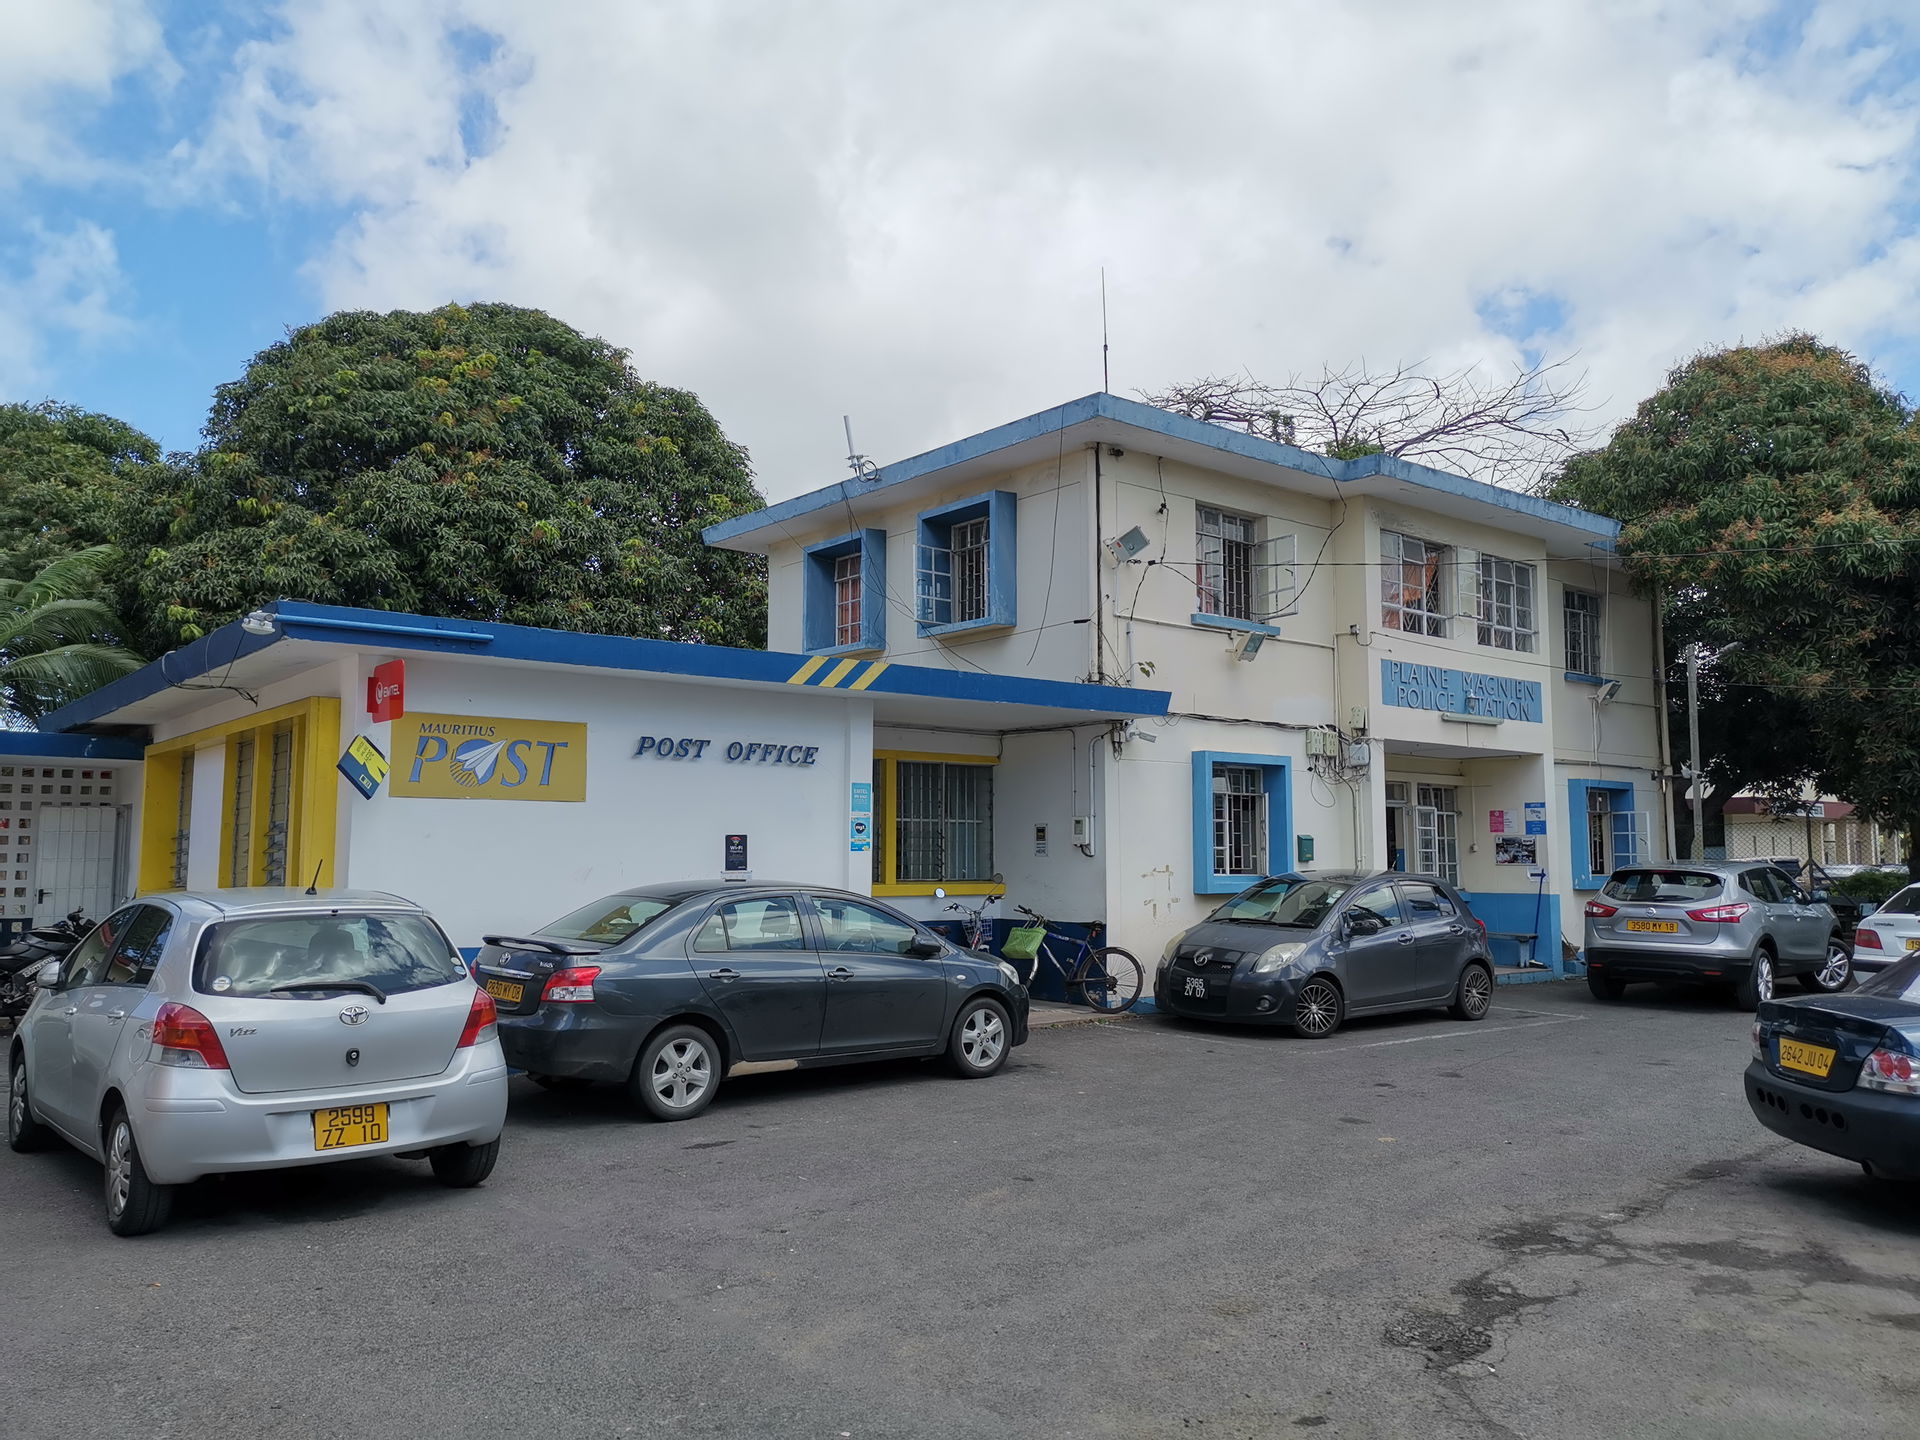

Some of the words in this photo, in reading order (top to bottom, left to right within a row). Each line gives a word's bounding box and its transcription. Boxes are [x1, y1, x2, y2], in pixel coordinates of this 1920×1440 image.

[1391, 660, 1449, 690] PLAINE
[1462, 671, 1535, 702] MAGNIEN
[1396, 685, 1456, 713] POLICE
[419, 722, 496, 737] MAURITIUS
[408, 735, 569, 788] POST
[636, 736, 711, 759] POST
[727, 741, 819, 765] OFFICE
[1186, 977, 1204, 988] 5365
[1195, 988, 1205, 998] 07
[1781, 1044, 1804, 1064] 2642
[1804, 1050, 1817, 1067] JU
[1817, 1053, 1830, 1071] 04
[328, 1105, 375, 1128] 2599
[322, 1127, 346, 1148] ZZ
[361, 1122, 381, 1143] 10
